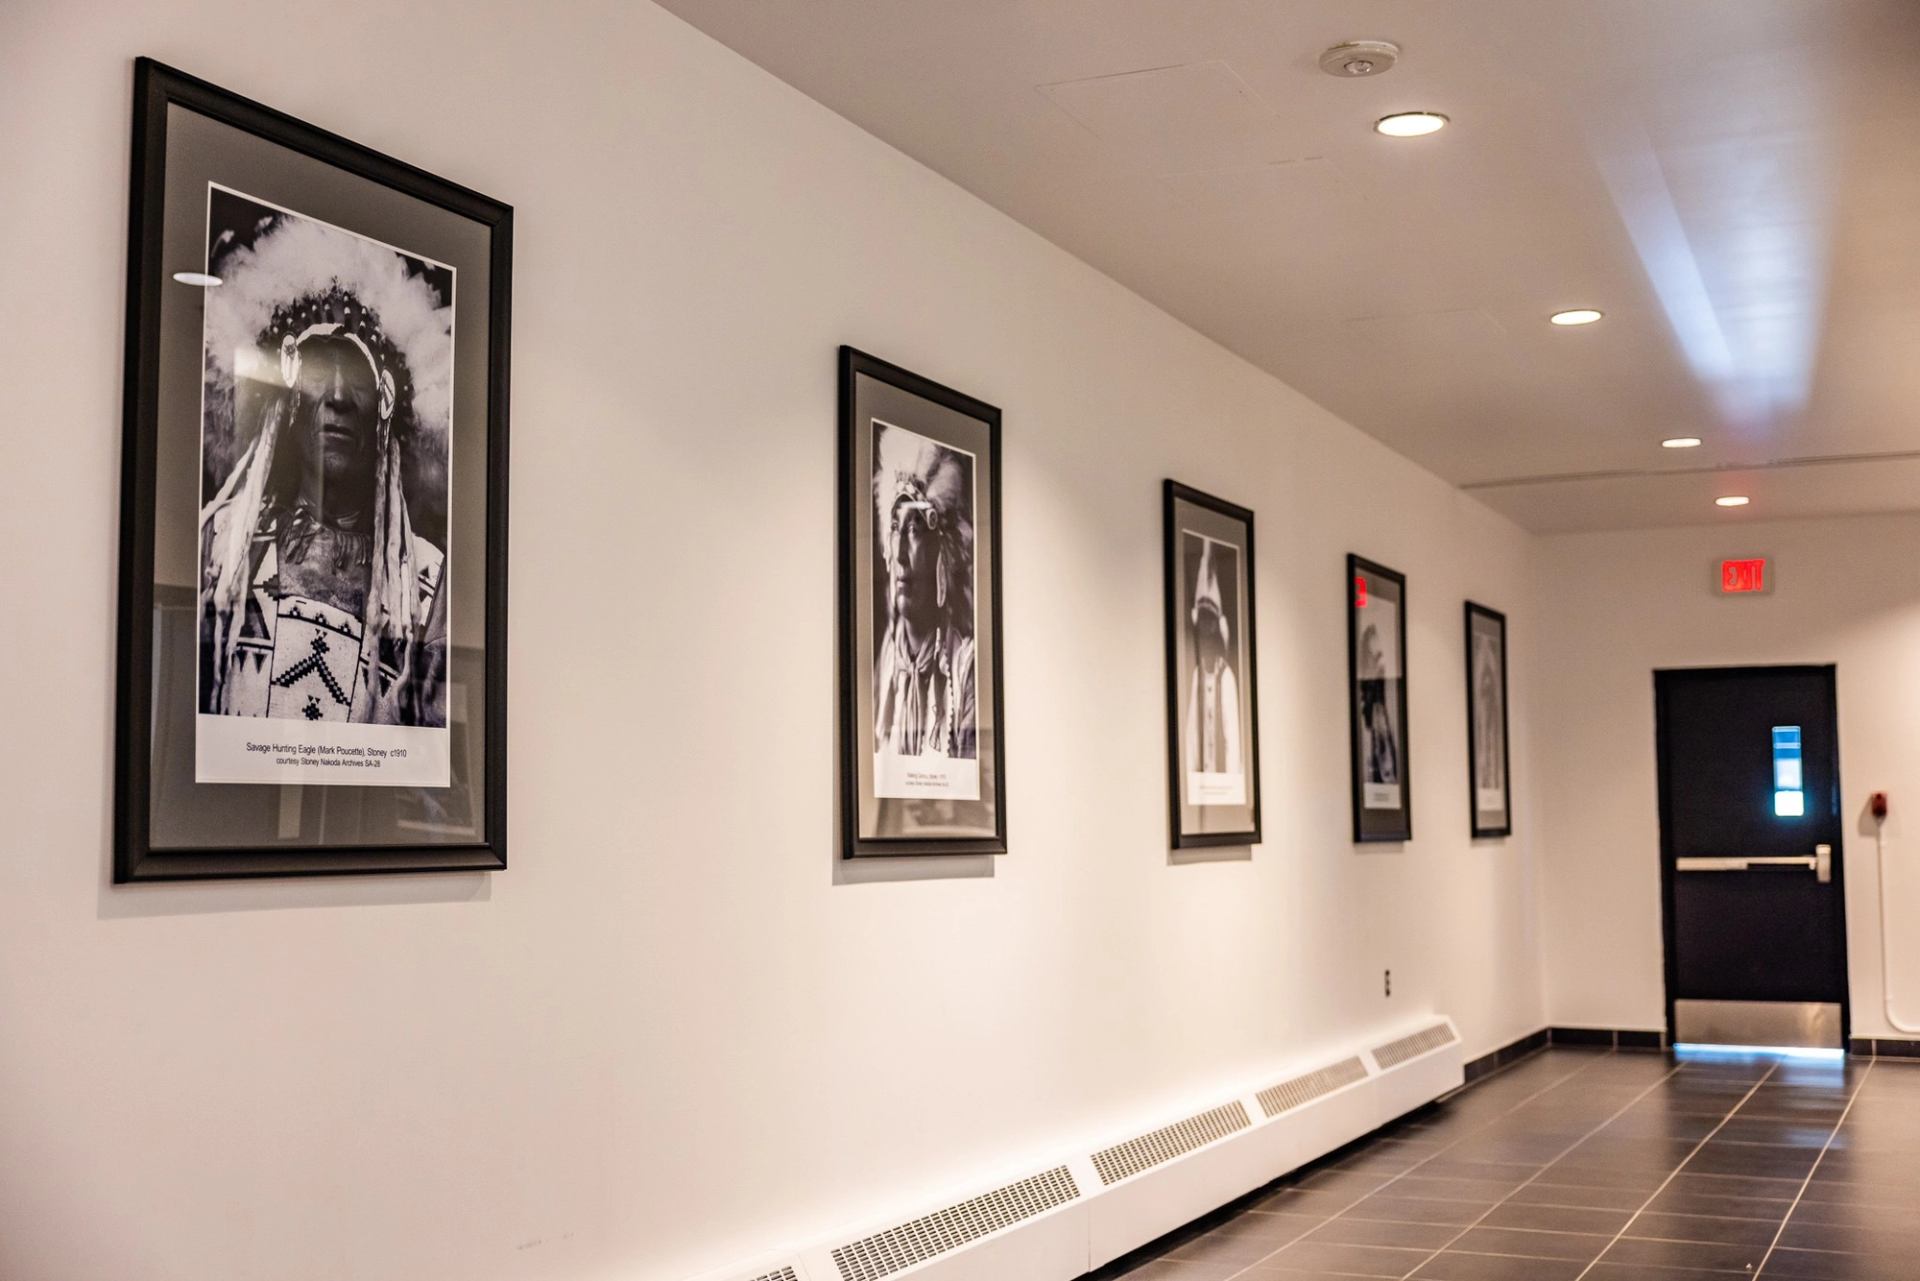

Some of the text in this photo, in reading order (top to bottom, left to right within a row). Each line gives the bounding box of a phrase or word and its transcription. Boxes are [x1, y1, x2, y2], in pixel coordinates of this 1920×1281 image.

[1720, 559, 1765, 587] EXIT
[246, 742, 271, 754] Savage
[272, 744, 297, 755] Hunting
[298, 744, 316, 755] Eagle
[317, 745, 335, 756] (Mark
[367, 747, 387, 758] Stoney
[390, 748, 407, 758] c1910
[276, 757, 299, 766] courtesy
[300, 757, 319, 767] Stoney
[320, 758, 340, 766] Nakoda
[342, 759, 363, 767] Archives
